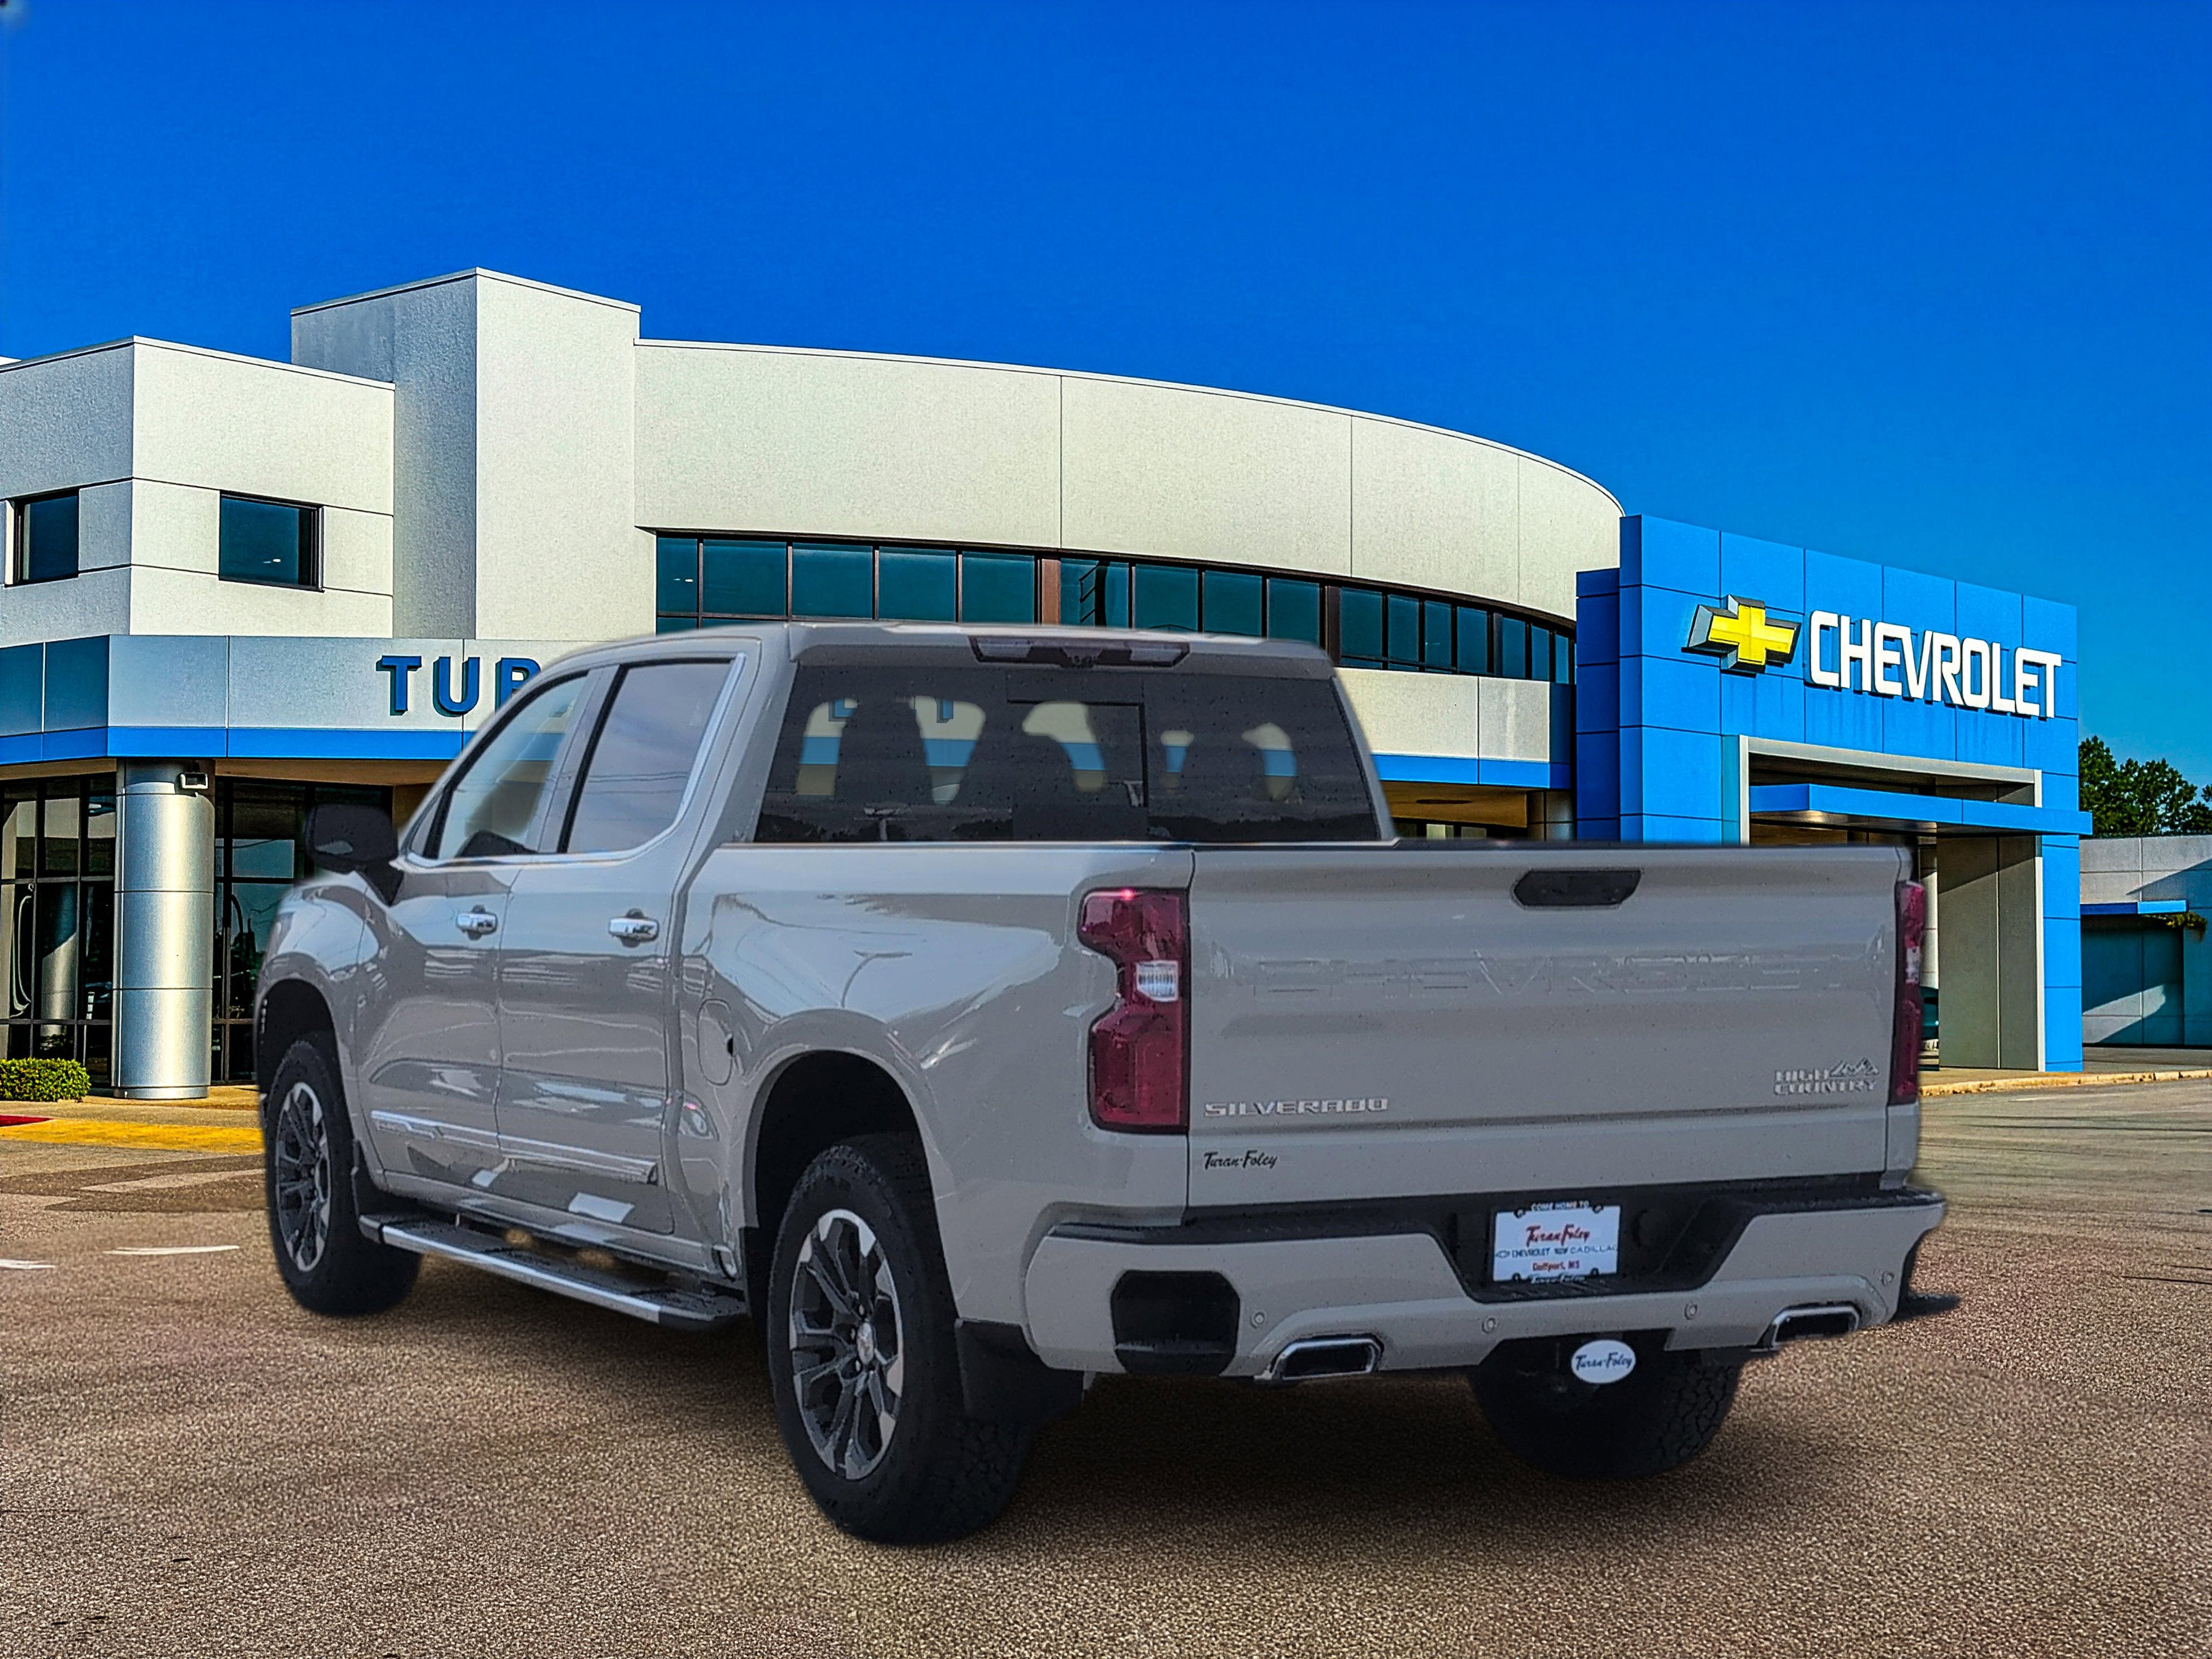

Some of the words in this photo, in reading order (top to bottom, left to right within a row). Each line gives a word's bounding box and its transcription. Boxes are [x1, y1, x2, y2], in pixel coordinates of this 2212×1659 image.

[1809, 610, 2062, 718] CHEVROLET
[1204, 1097, 1388, 1117] SILVERADO
[1203, 1149, 1277, 1169] Turan-Foley
[1512, 1248, 1550, 1257] CHEVROLET
